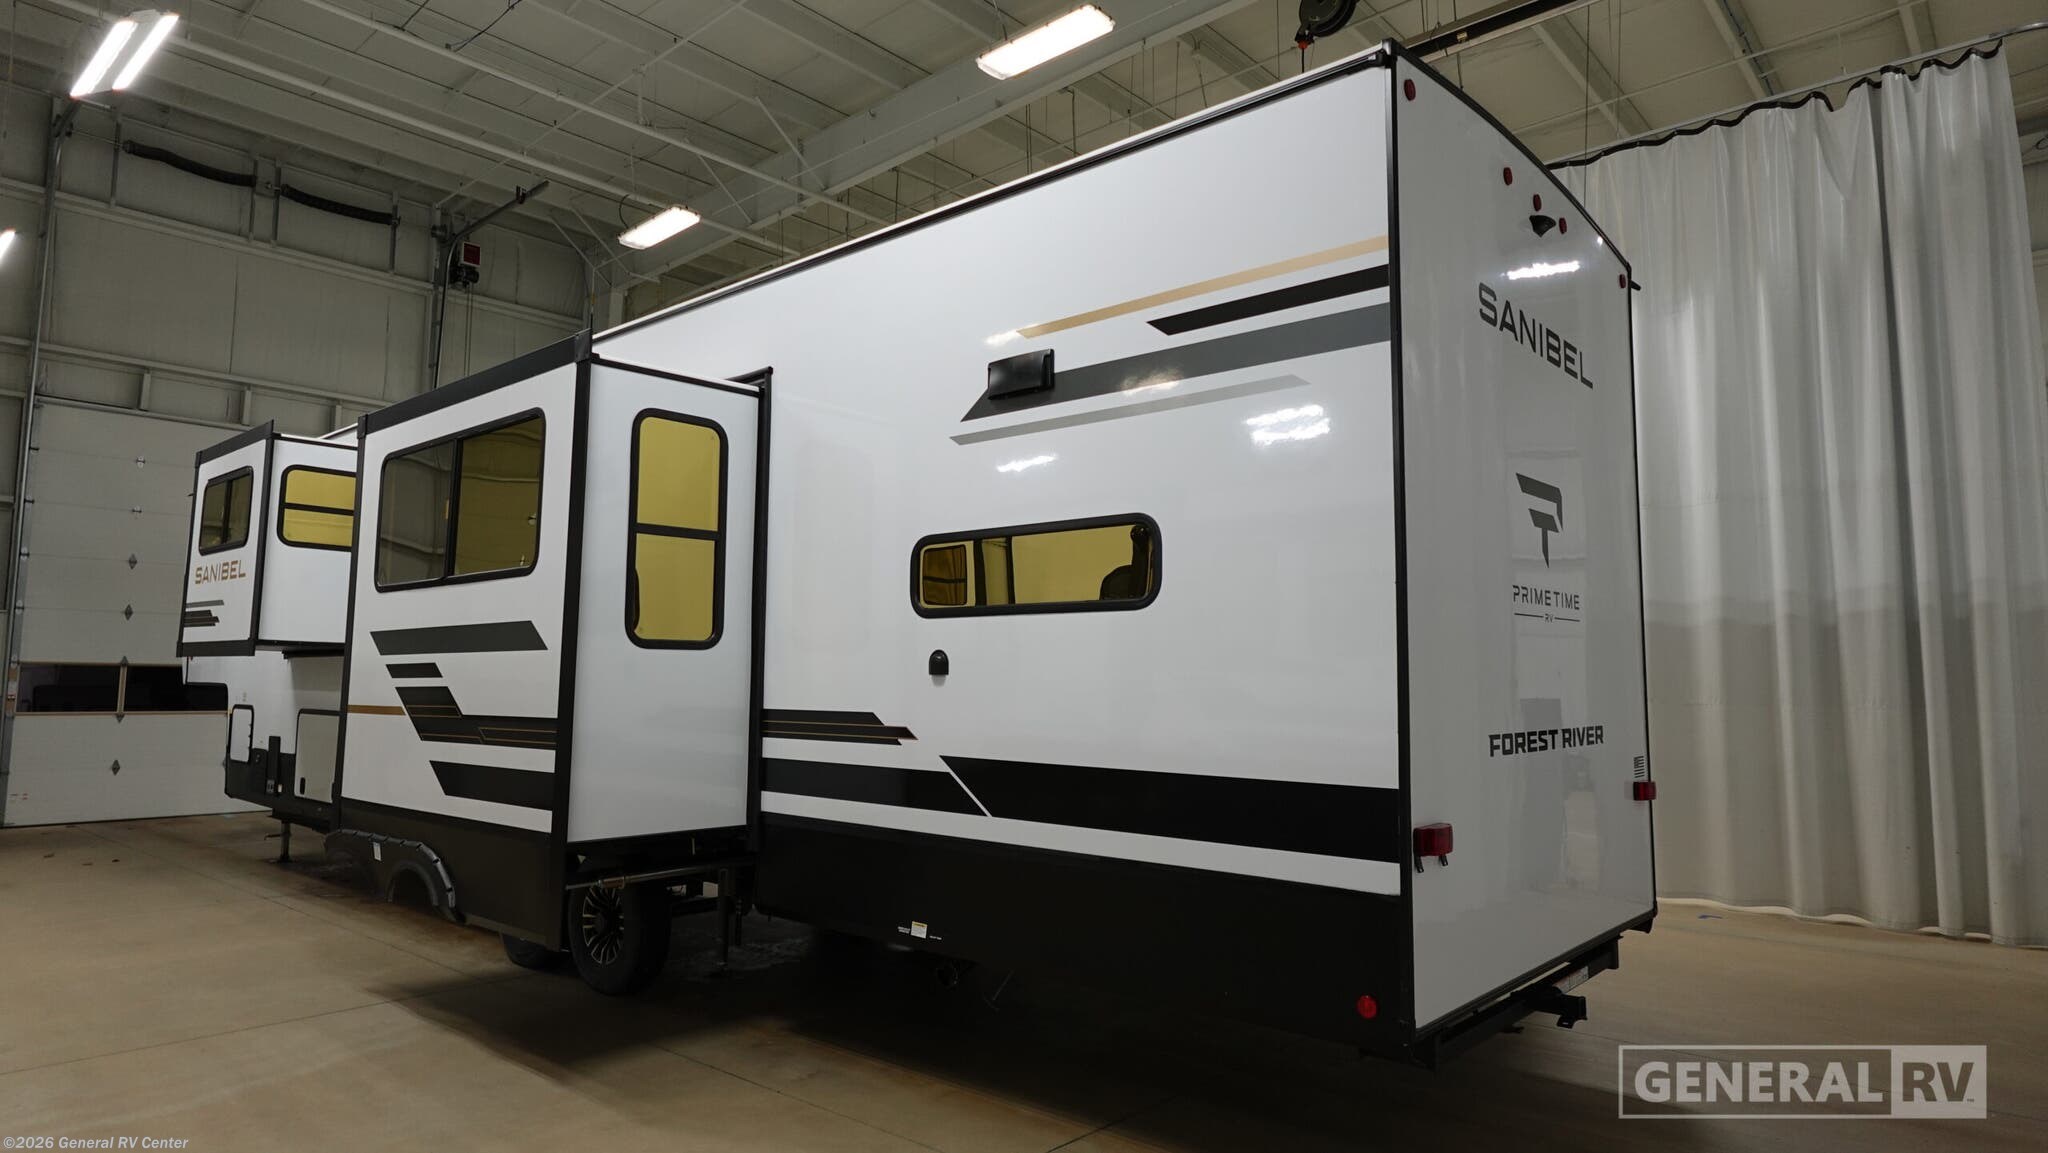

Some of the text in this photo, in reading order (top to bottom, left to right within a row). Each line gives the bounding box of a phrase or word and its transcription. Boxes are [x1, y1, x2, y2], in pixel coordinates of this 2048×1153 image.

[1479, 282, 1594, 389] SANIBEL
[195, 560, 247, 585] SANIBEL
[1488, 725, 1604, 757] FOREST RIVER
